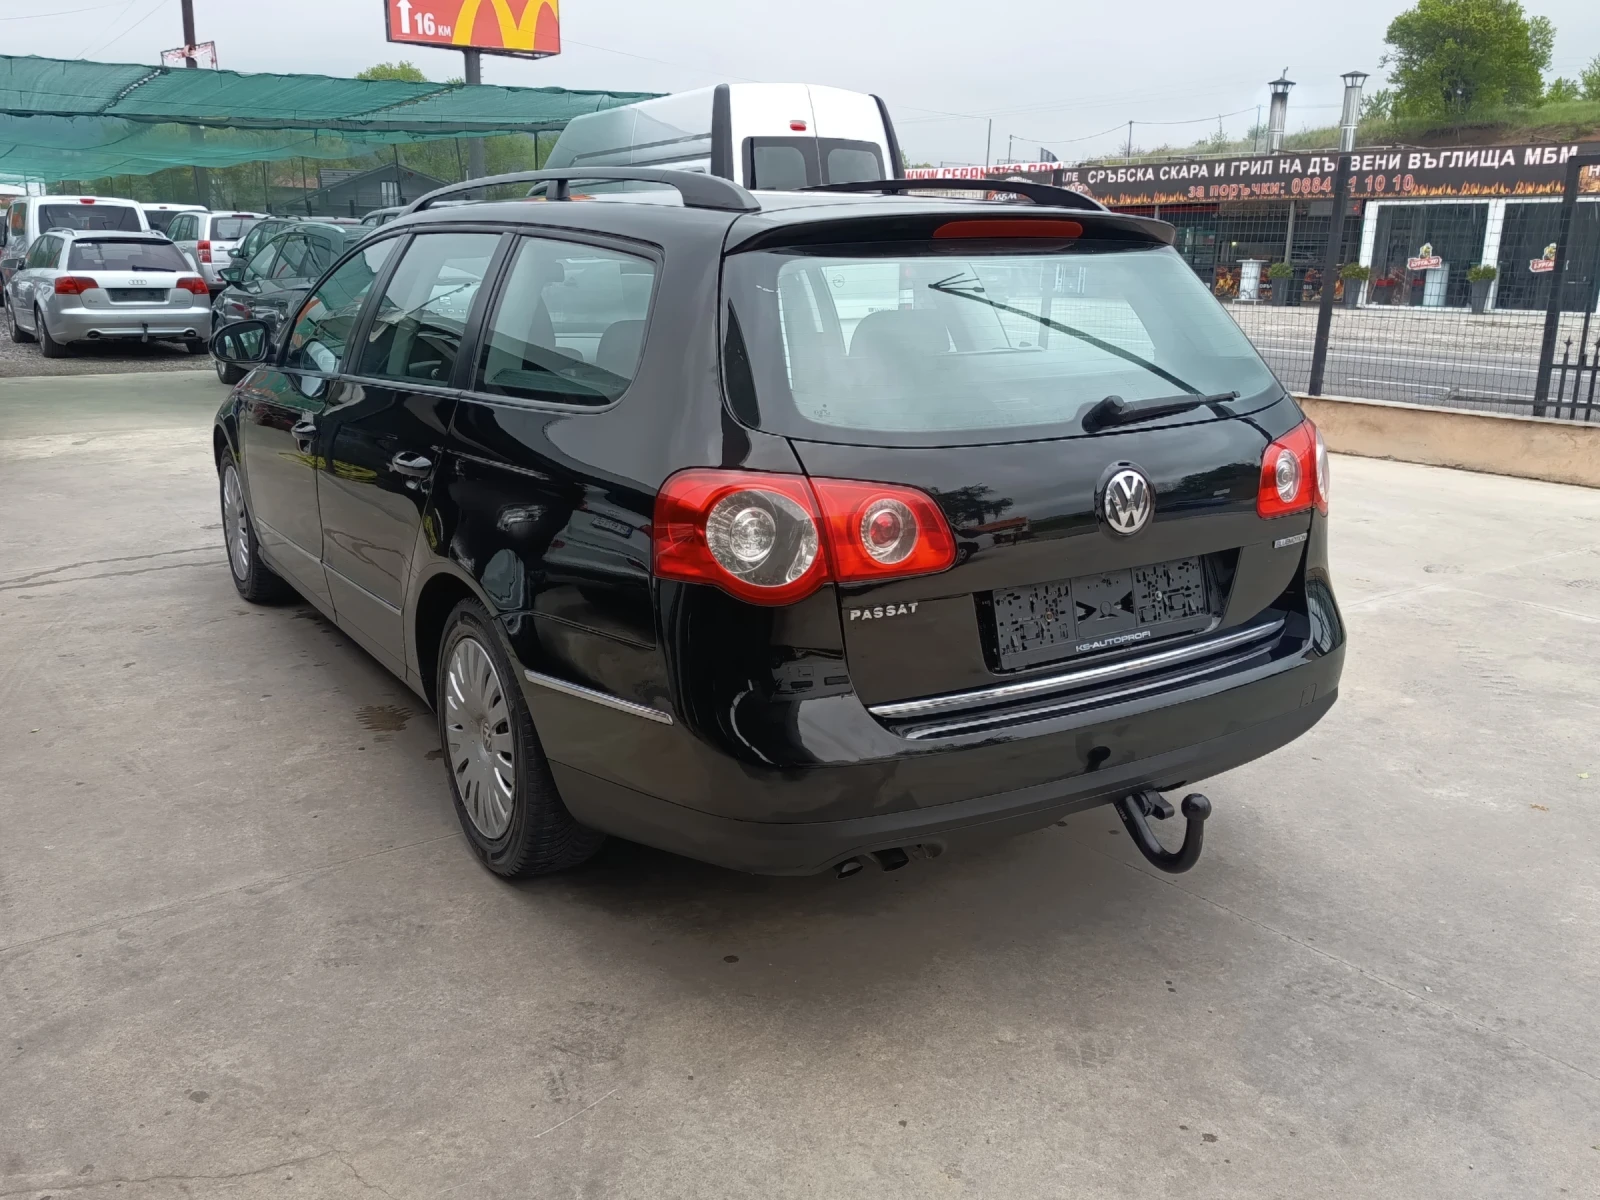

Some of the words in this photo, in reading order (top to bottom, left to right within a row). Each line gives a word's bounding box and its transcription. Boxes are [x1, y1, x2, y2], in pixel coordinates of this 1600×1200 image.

[414, 12, 436, 36] 16
[1087, 167, 1154, 184] СРЪБСКА
[1159, 163, 1208, 181] СКАРА
[1214, 162, 1225, 177] И
[1230, 159, 1273, 177] ГРИЛ
[1279, 158, 1302, 174] НА
[1307, 152, 1401, 176] ДЪВЕНИ
[1407, 149, 1516, 170] ВЪГЛИЩА
[1524, 145, 1578, 166] МБМ
[1187, 186, 1205, 198] за
[1209, 182, 1286, 202] поръчки:
[1291, 176, 1332, 194] 0884
[1364, 174, 1386, 192] 10
[1392, 173, 1414, 192] 10
[849, 602, 919, 621] PASSAT
[1075, 630, 1151, 652] KS-AUTOPROFI
